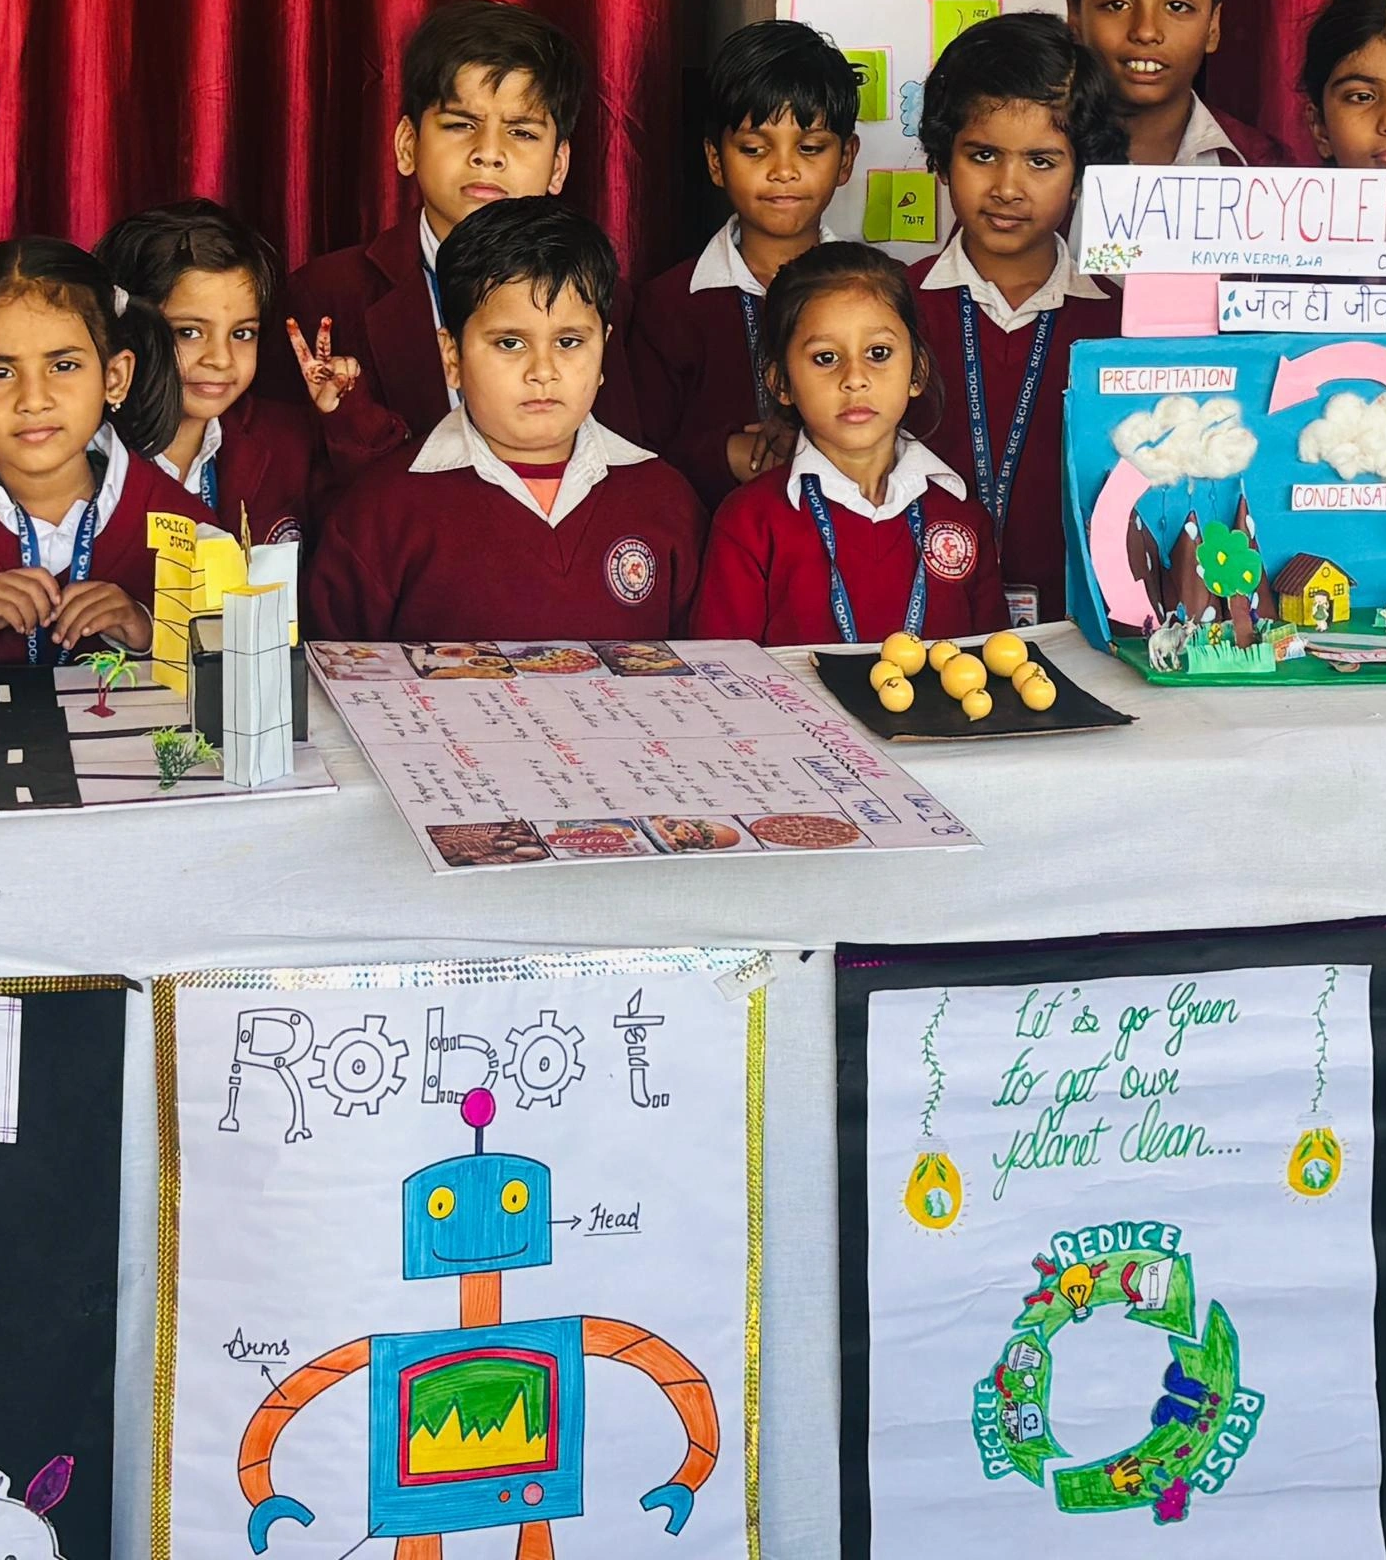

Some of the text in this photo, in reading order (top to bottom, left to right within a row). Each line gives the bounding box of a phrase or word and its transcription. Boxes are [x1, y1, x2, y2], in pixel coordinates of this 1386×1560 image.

[1192, 250, 1239, 266] KAVYA
[1245, 289, 1299, 321] जल
[1304, 282, 1333, 322] ही
[1102, 368, 1234, 391] PRECIPITATION
[155, 516, 189, 535] POLICE
[1113, 1006, 1165, 1061] go
[1155, 981, 1242, 1058] Green
[992, 1046, 1182, 1132] to get our
[991, 1104, 1113, 1201] planet
[590, 1201, 643, 1231] Head
[1053, 1222, 1182, 1270] REDUCE
[222, 1326, 292, 1360] Arms
[976, 1381, 1015, 1477] RECYCLE
[1191, 1391, 1264, 1494] REUSE
